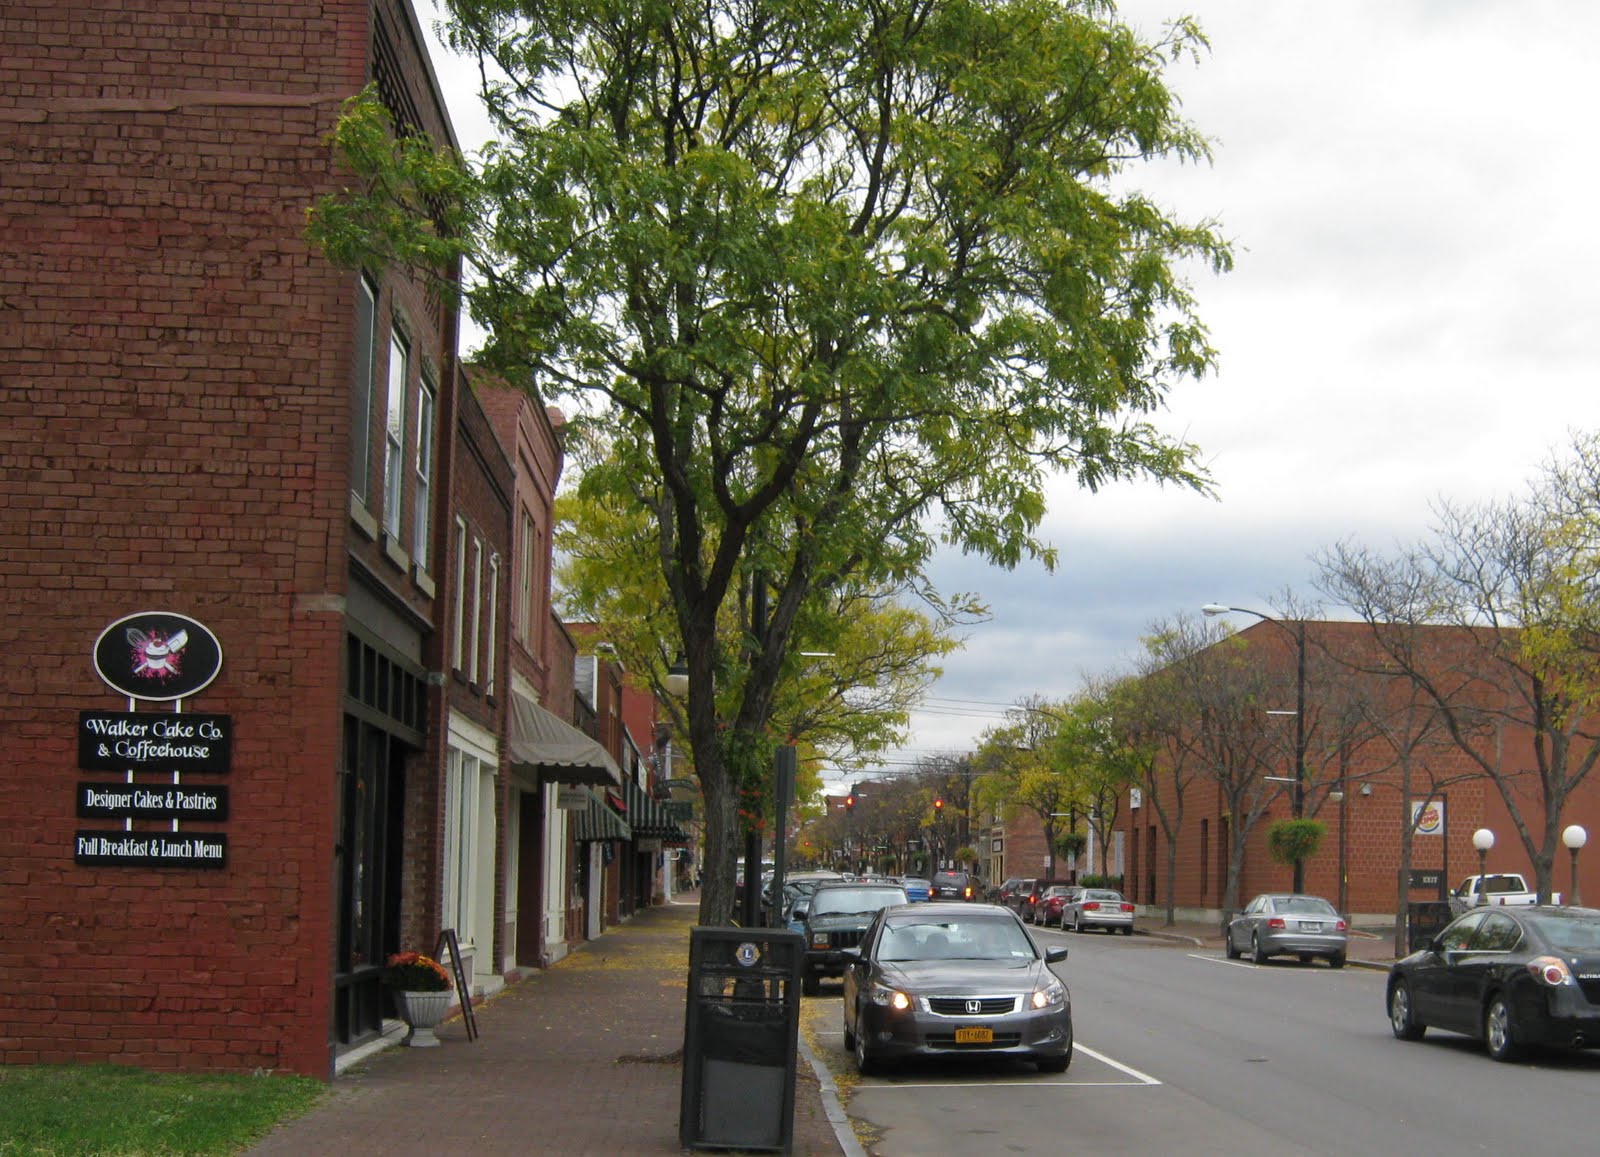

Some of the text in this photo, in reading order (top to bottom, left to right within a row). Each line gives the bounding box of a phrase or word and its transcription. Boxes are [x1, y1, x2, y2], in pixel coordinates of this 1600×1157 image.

[86, 719, 223, 739] Walker Cake Co.
[98, 739, 210, 760] & Coffeehouse
[86, 789, 217, 810] Designer Cakes & Pastries
[78, 838, 222, 858] Full Breakfast & Lunch Menu
[1423, 876, 1437, 884] EXIT
